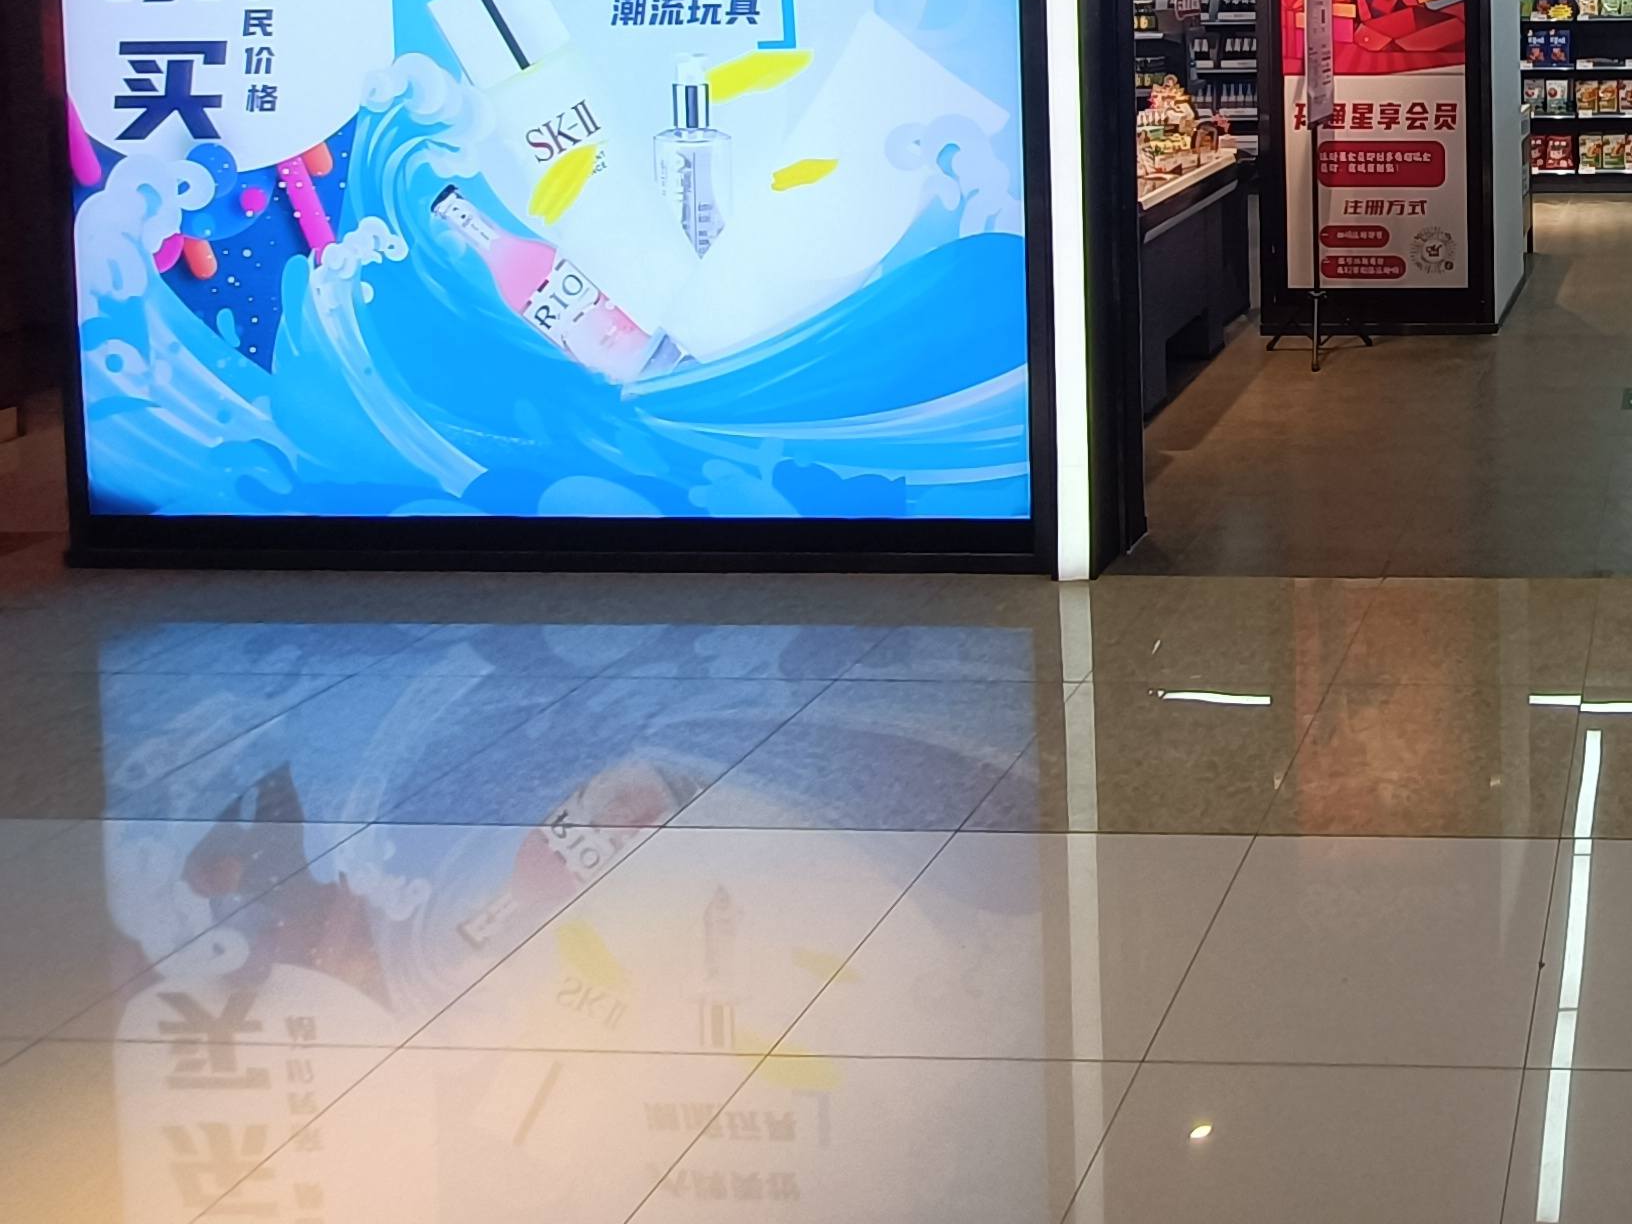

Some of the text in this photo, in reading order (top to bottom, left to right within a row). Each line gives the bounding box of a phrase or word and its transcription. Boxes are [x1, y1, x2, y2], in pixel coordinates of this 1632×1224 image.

[1343, 199, 1428, 216] 注册方式
[534, 273, 584, 330] RIO
